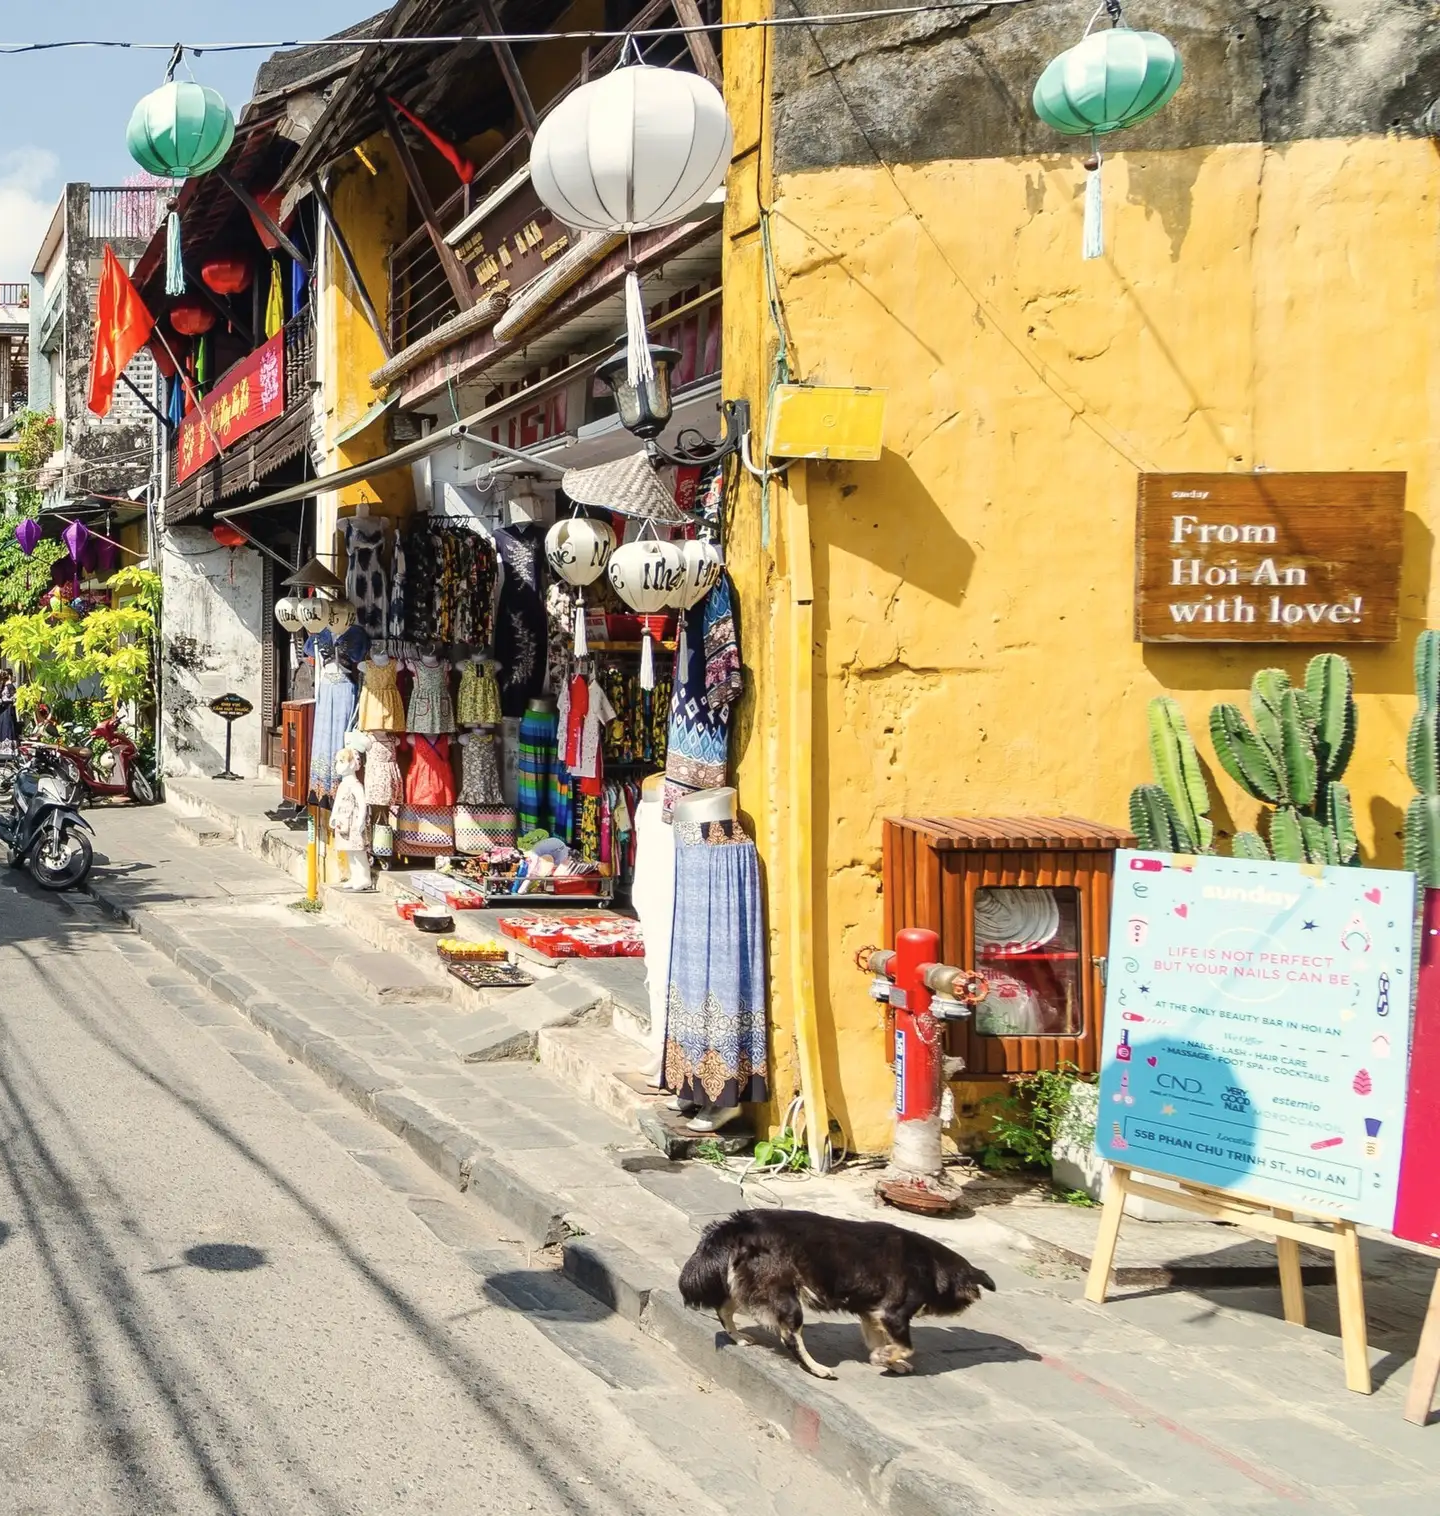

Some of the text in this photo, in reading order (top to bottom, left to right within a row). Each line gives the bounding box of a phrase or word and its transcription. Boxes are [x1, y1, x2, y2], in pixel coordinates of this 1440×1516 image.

[1171, 489, 1209, 500] sunday
[1169, 515, 1278, 544] From
[1169, 557, 1308, 586] Hoi An
[1168, 595, 1363, 624] with love!
[1202, 884, 1301, 911] sunday
[1168, 946, 1334, 968] LIFE IS NOT PERFECT
[1154, 960, 1350, 986] BUT YOUR NAILS CAN BE
[1155, 1000, 1341, 1036] AT THE ONLY BEAUTY BAR IN HOI AN
[1167, 1047, 1330, 1083] MASSAGE FOOT SPA COCKTAILS
[1187, 1040, 1308, 1068] NAILS LASH HAIR CARE
[1156, 1073, 1203, 1094] CND
[1225, 1085, 1249, 1097] VERY
[1216, 1132, 1256, 1148] Location
[1158, 1134, 1193, 1149] PHAN
[1195, 1143, 1223, 1157] CHU
[1226, 1149, 1266, 1166] TRINH
[1296, 1165, 1322, 1179] HOI
[1325, 1173, 1346, 1186] AN
